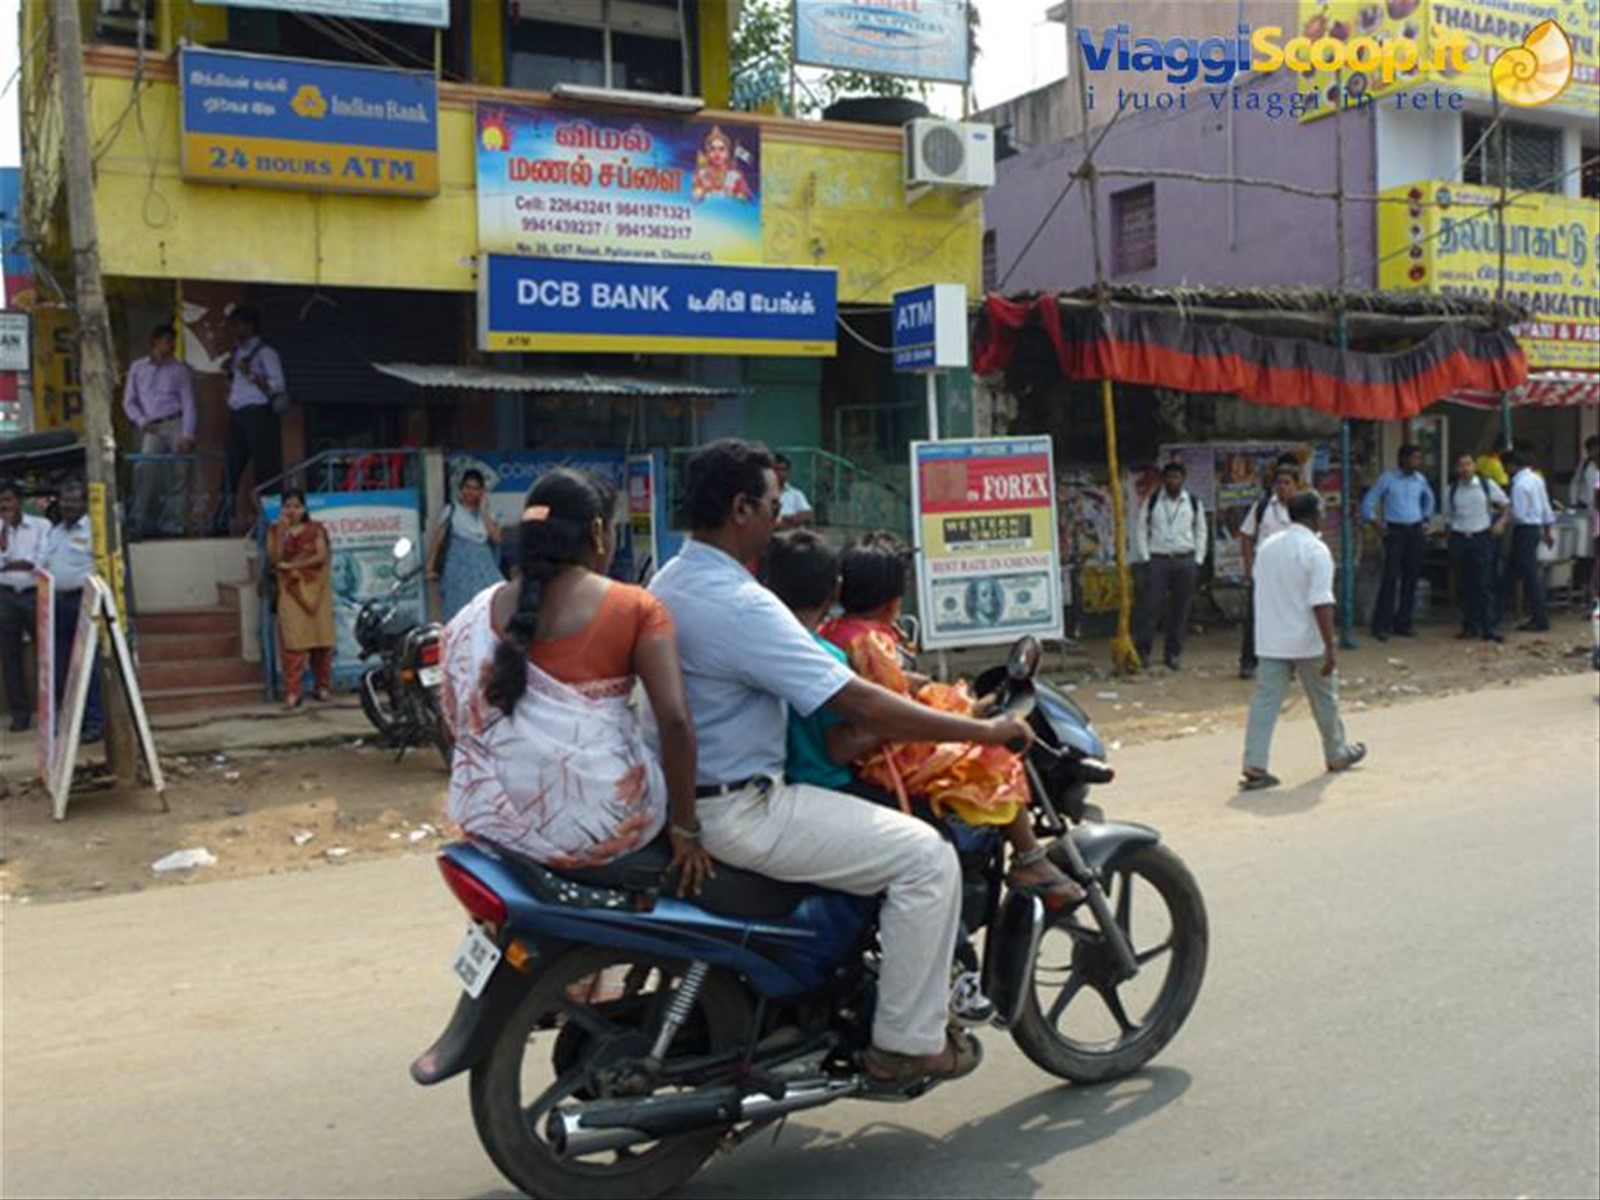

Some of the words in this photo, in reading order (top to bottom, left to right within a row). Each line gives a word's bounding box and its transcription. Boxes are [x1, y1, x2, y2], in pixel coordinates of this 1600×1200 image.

[331, 94, 385, 117] Indian
[386, 100, 429, 124] Bank
[209, 146, 249, 170] 24
[255, 156, 332, 175] HOURS
[341, 155, 416, 182] ATM
[517, 279, 581, 307] DCB
[590, 283, 670, 311] BANK
[897, 300, 933, 331] ATM
[983, 472, 1049, 501] FOREX
